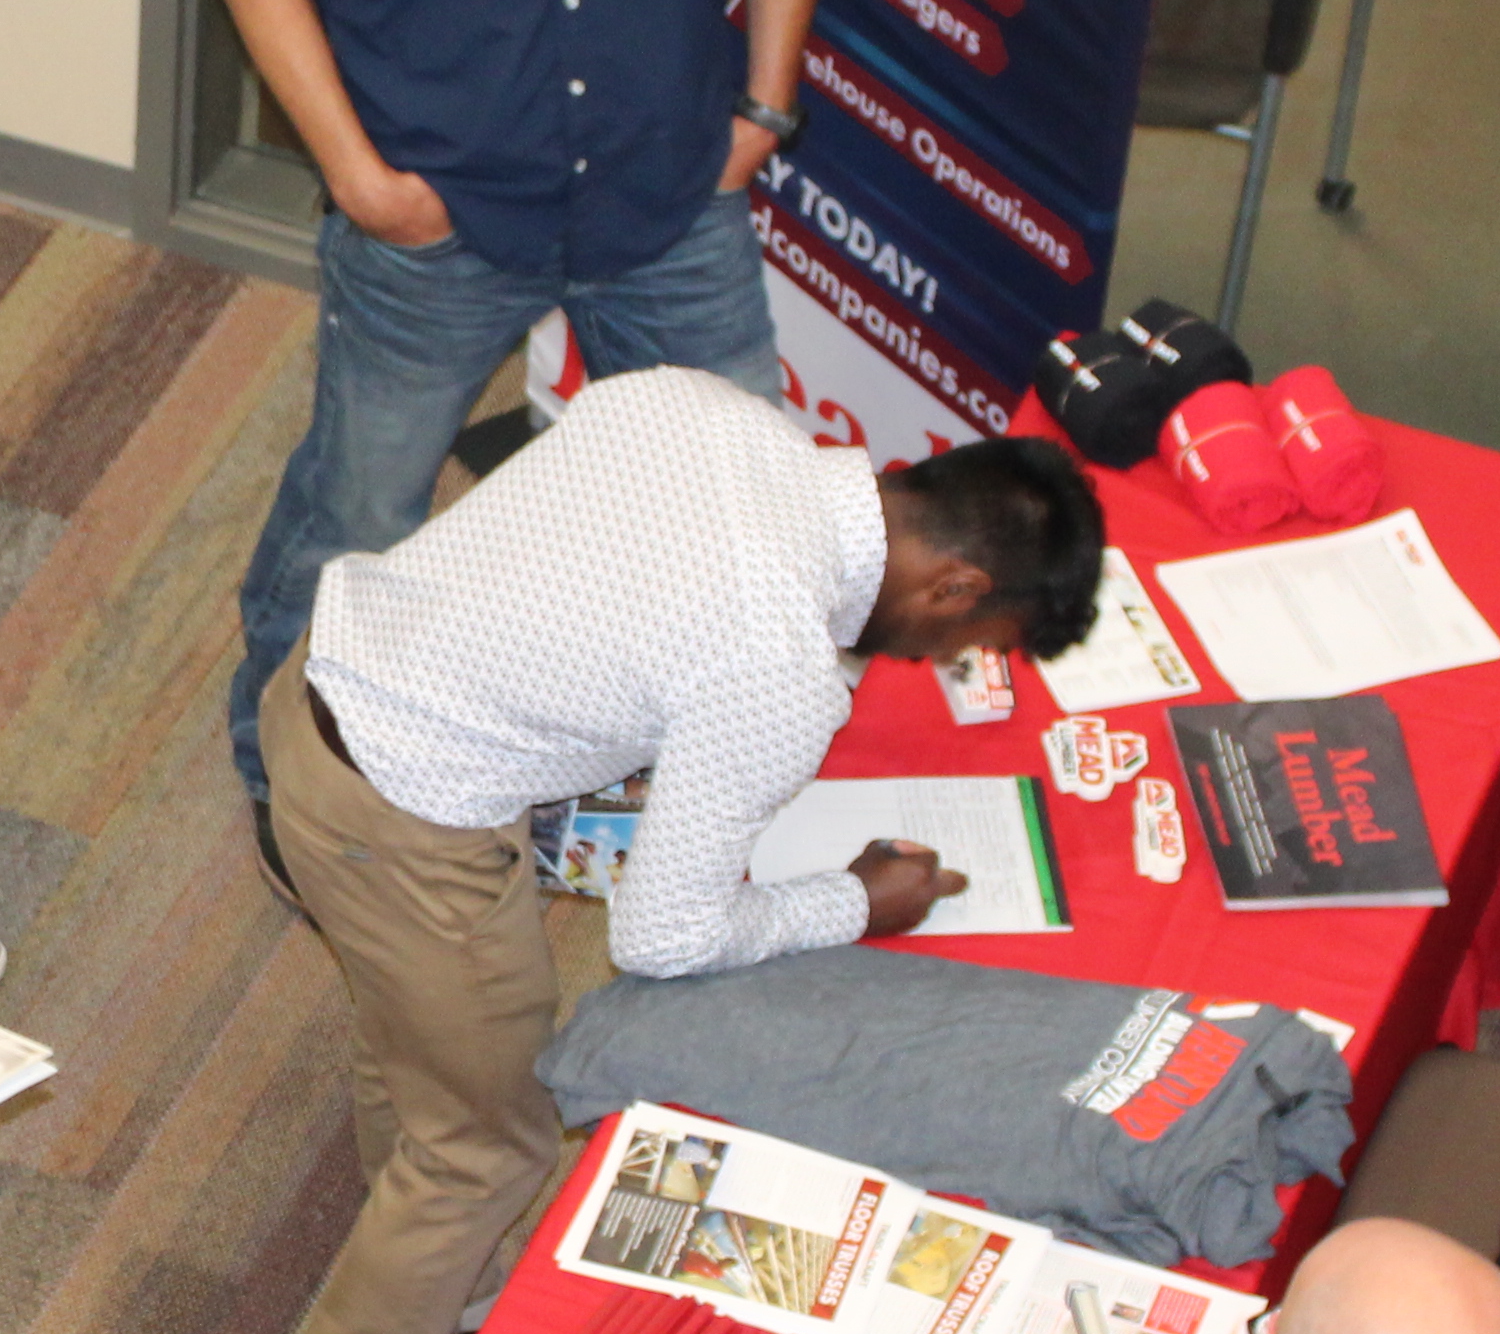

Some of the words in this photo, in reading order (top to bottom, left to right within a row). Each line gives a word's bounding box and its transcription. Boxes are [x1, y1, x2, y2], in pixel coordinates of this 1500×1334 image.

[910, 124, 1072, 270] Operations
[800, 176, 939, 314] TODAY!
[751, 206, 1010, 436] dcompanies.co
[1071, 719, 1106, 786] MEAD
[1156, 809, 1181, 859] MEAD
[1274, 729, 1344, 868] Lumber
[1327, 744, 1397, 846] Mead
[850, 1191, 880, 1243] FLOOR
[820, 1241, 859, 1306] TRUSSES
[963, 1248, 1001, 1295] ROOF
